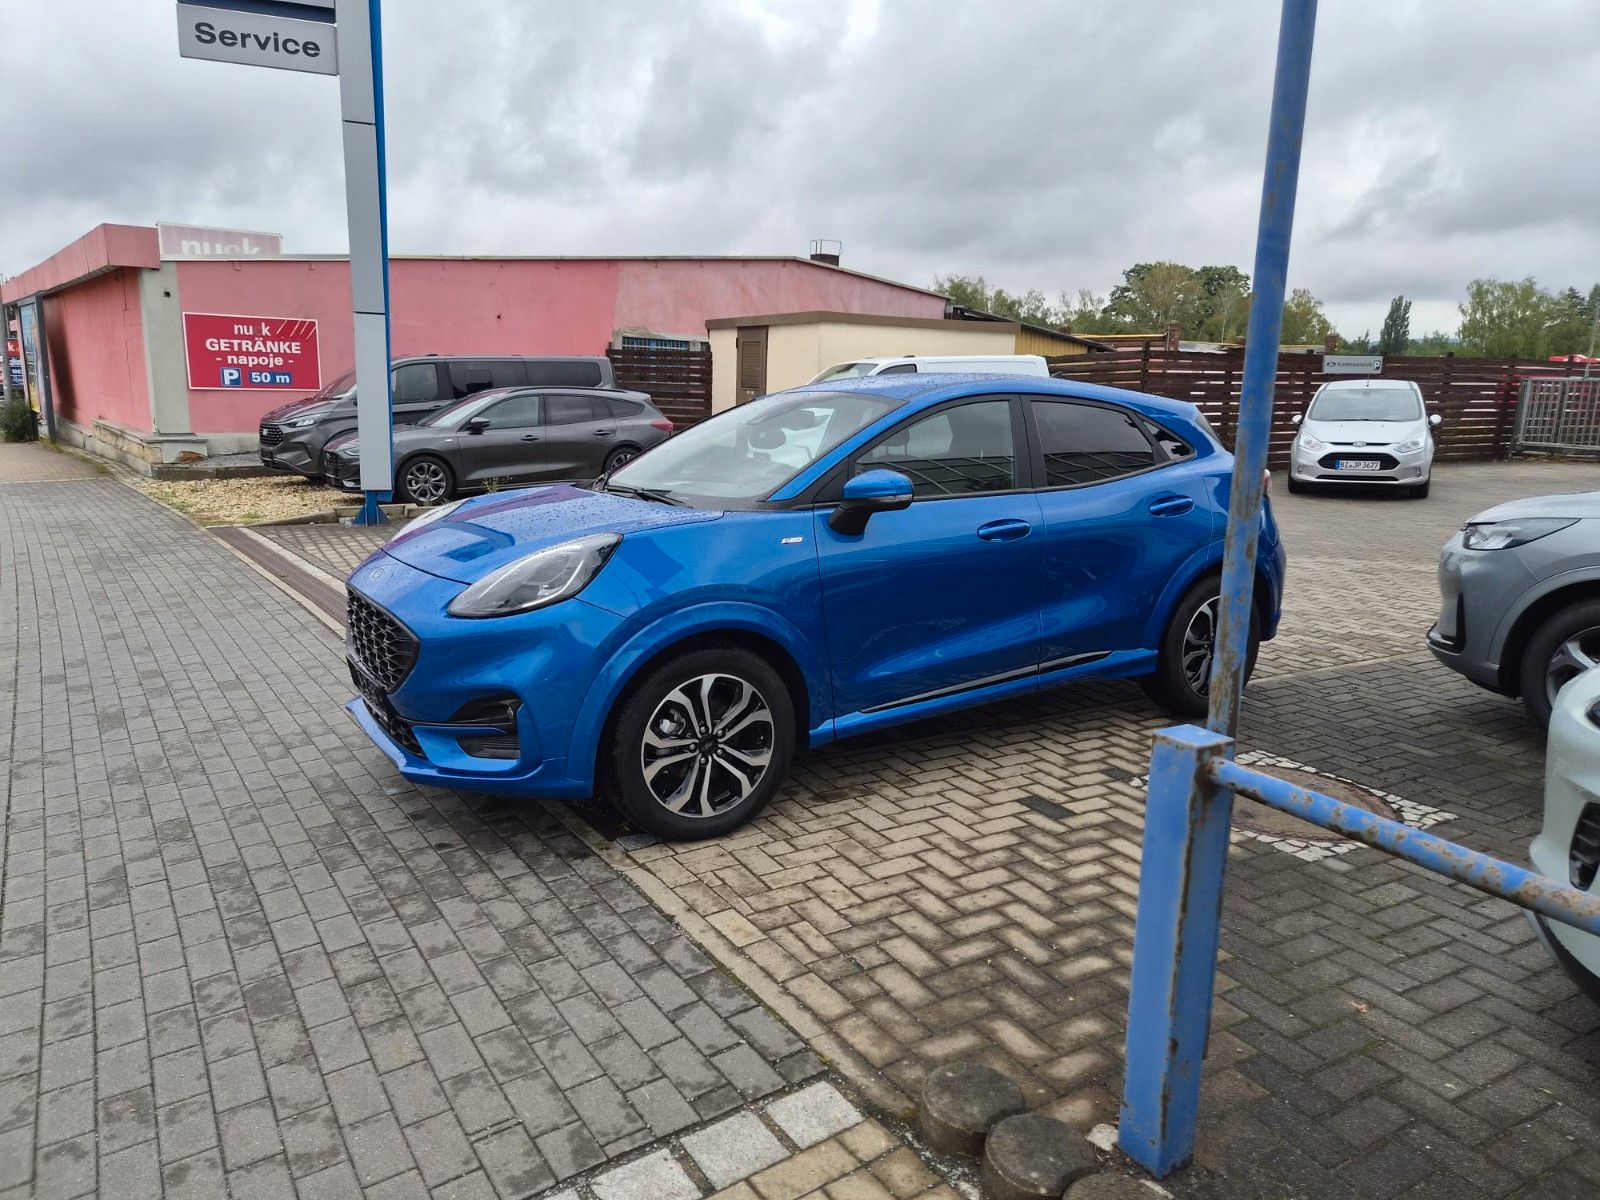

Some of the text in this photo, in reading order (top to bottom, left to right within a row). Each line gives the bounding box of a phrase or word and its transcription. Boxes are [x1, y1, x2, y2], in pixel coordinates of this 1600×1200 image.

[194, 22, 321, 58] Service
[205, 337, 301, 354] GETRÄNKE
[227, 353, 284, 368] napoje
[223, 369, 290, 385] P 50 m
